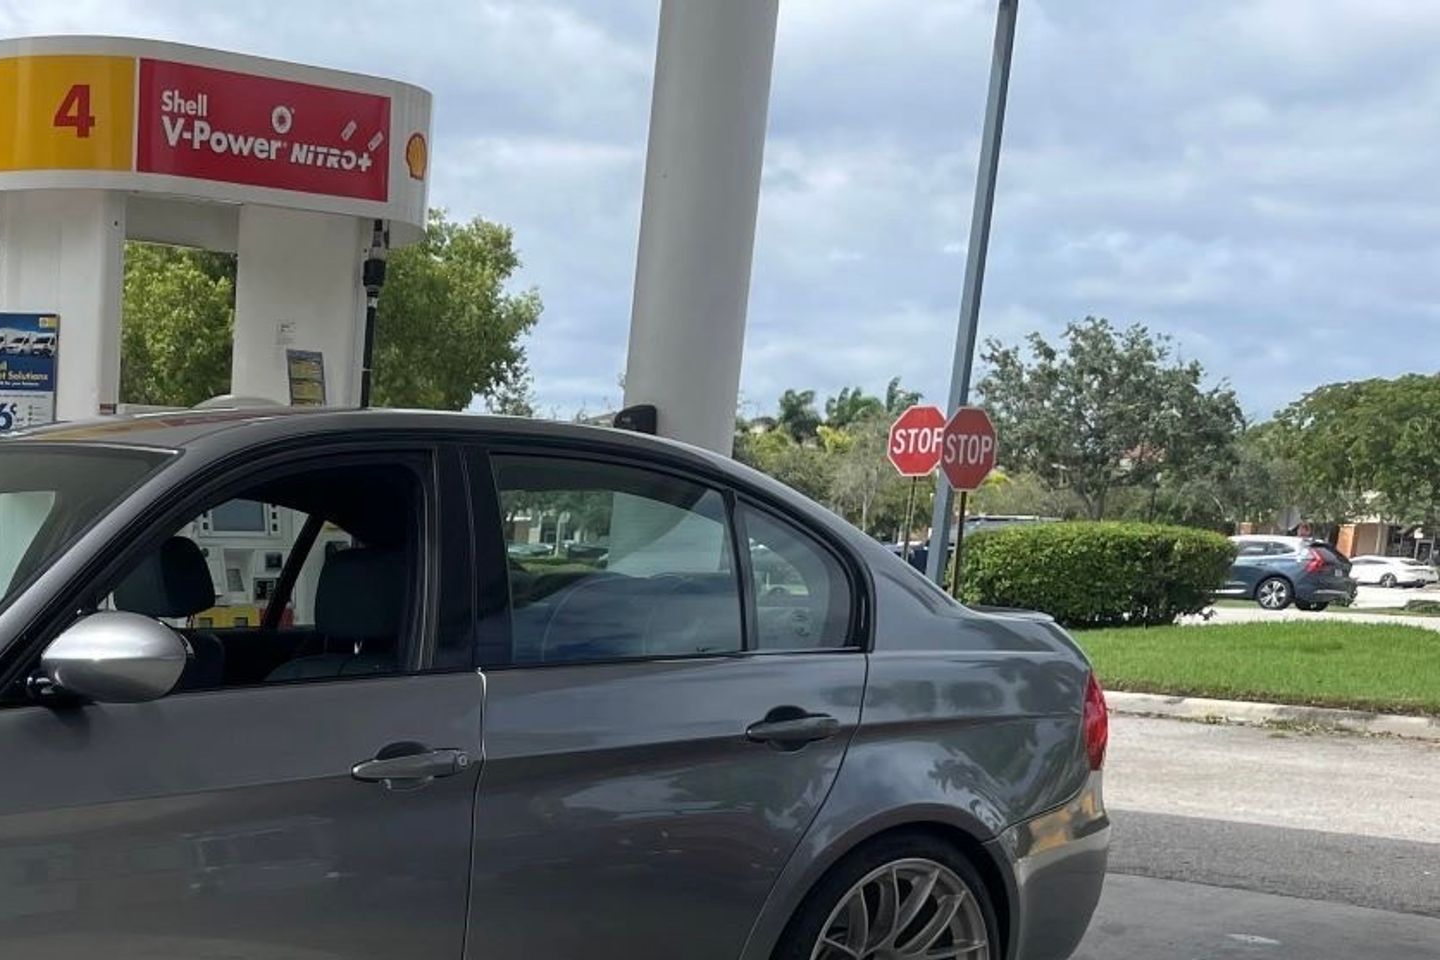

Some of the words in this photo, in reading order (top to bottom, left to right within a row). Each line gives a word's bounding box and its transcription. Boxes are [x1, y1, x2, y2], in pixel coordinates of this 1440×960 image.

[54, 84, 95, 138] 4
[161, 90, 208, 117] Shell
[162, 115, 282, 160] V-Power
[944, 434, 993, 465] STOP
